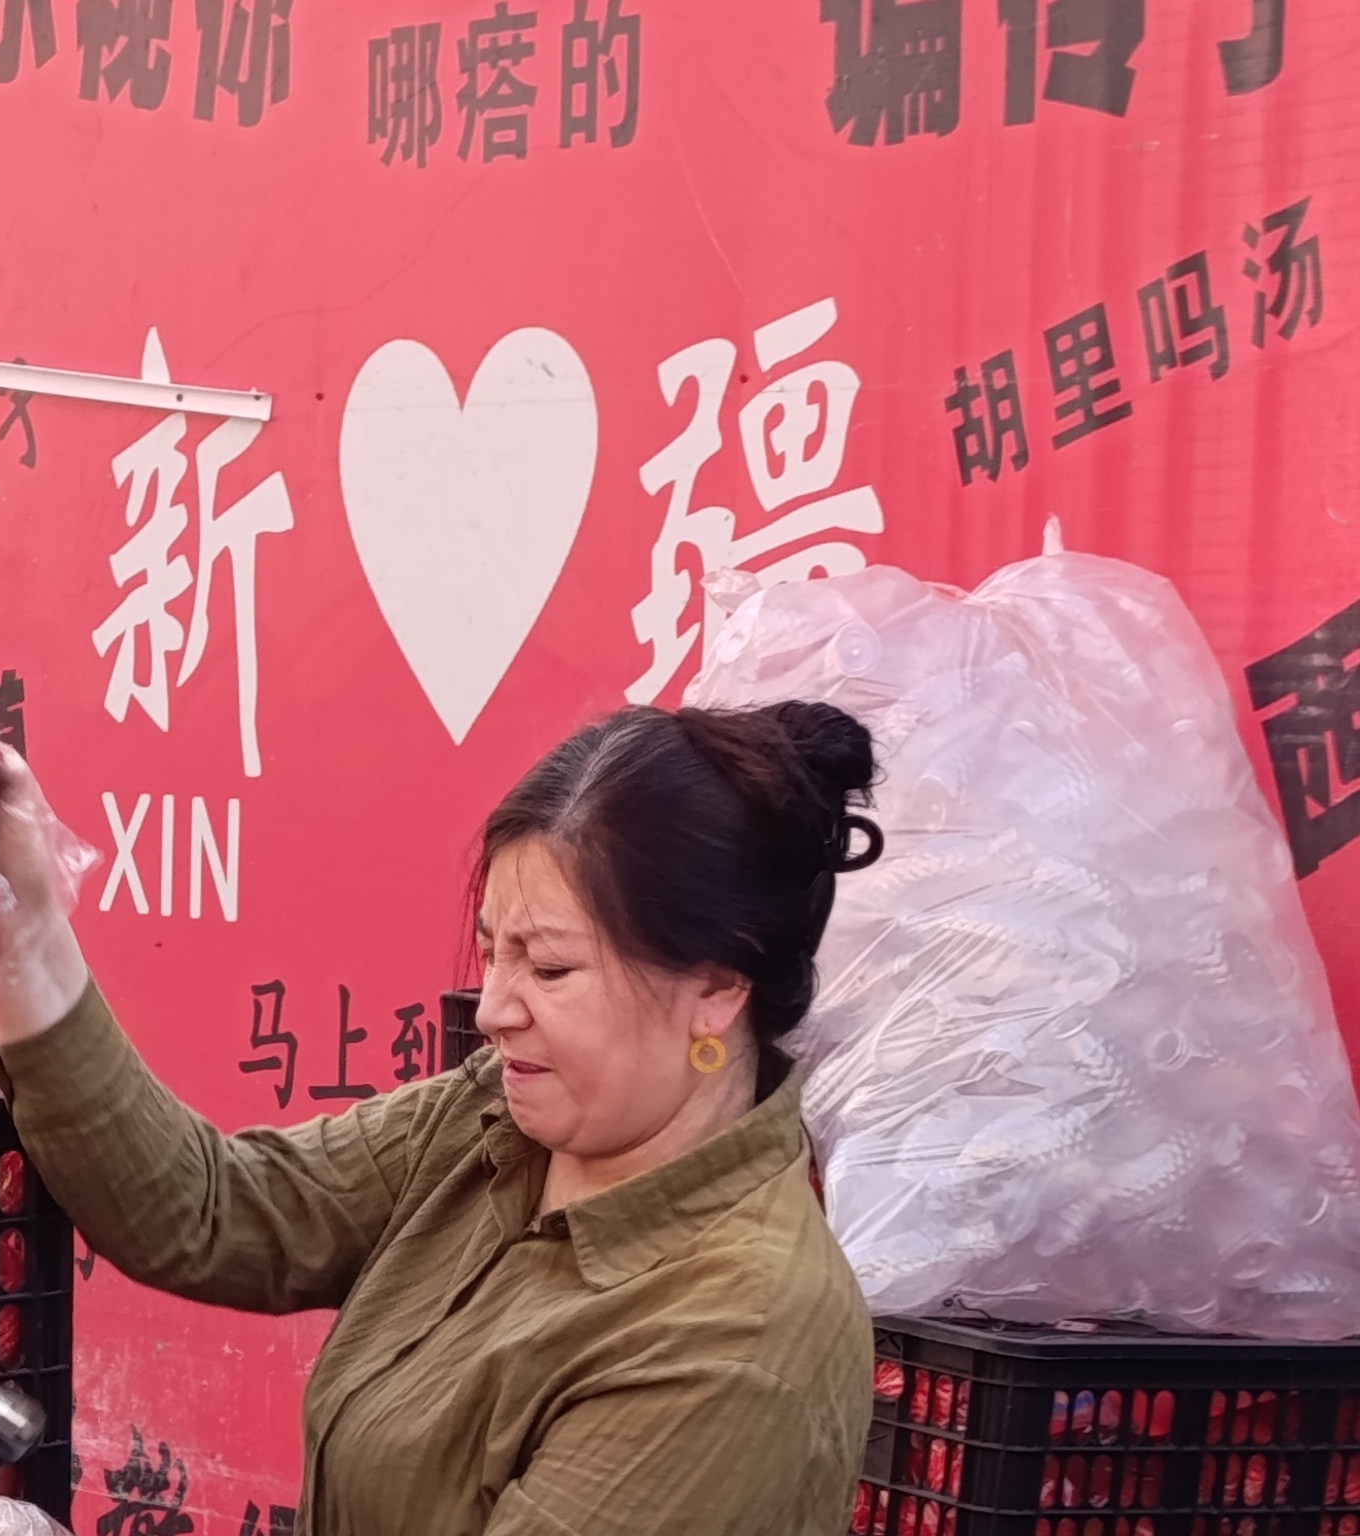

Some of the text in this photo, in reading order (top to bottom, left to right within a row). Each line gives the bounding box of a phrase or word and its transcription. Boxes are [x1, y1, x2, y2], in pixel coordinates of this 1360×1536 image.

[944, 198, 1324, 486] 胡里吗汤
[90, 297, 886, 778] 新 疆
[98, 791, 241, 923] XIN
